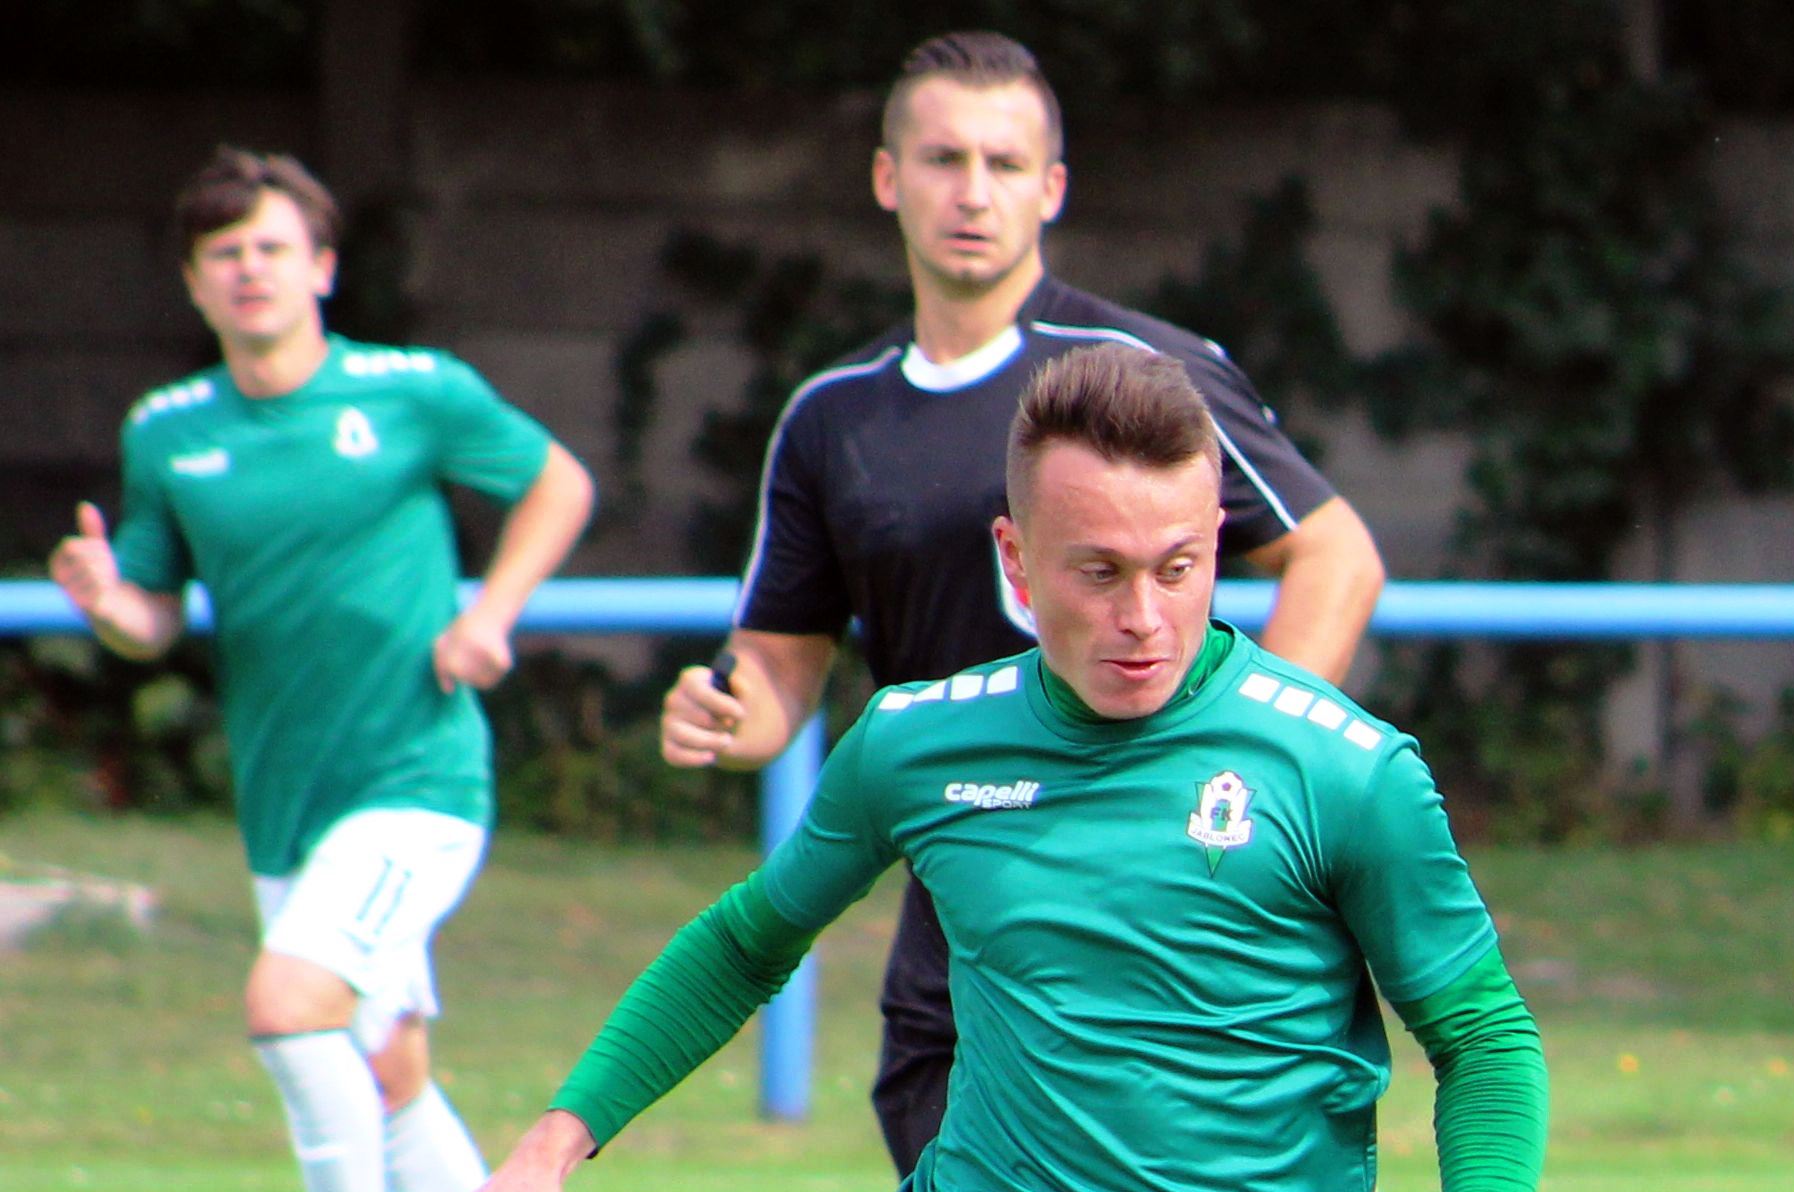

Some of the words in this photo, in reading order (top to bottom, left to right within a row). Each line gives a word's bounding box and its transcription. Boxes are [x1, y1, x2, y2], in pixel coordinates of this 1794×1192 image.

[943, 780, 1041, 807] capelli
[981, 799, 1032, 810] SPORT
[1210, 806, 1233, 822] FK
